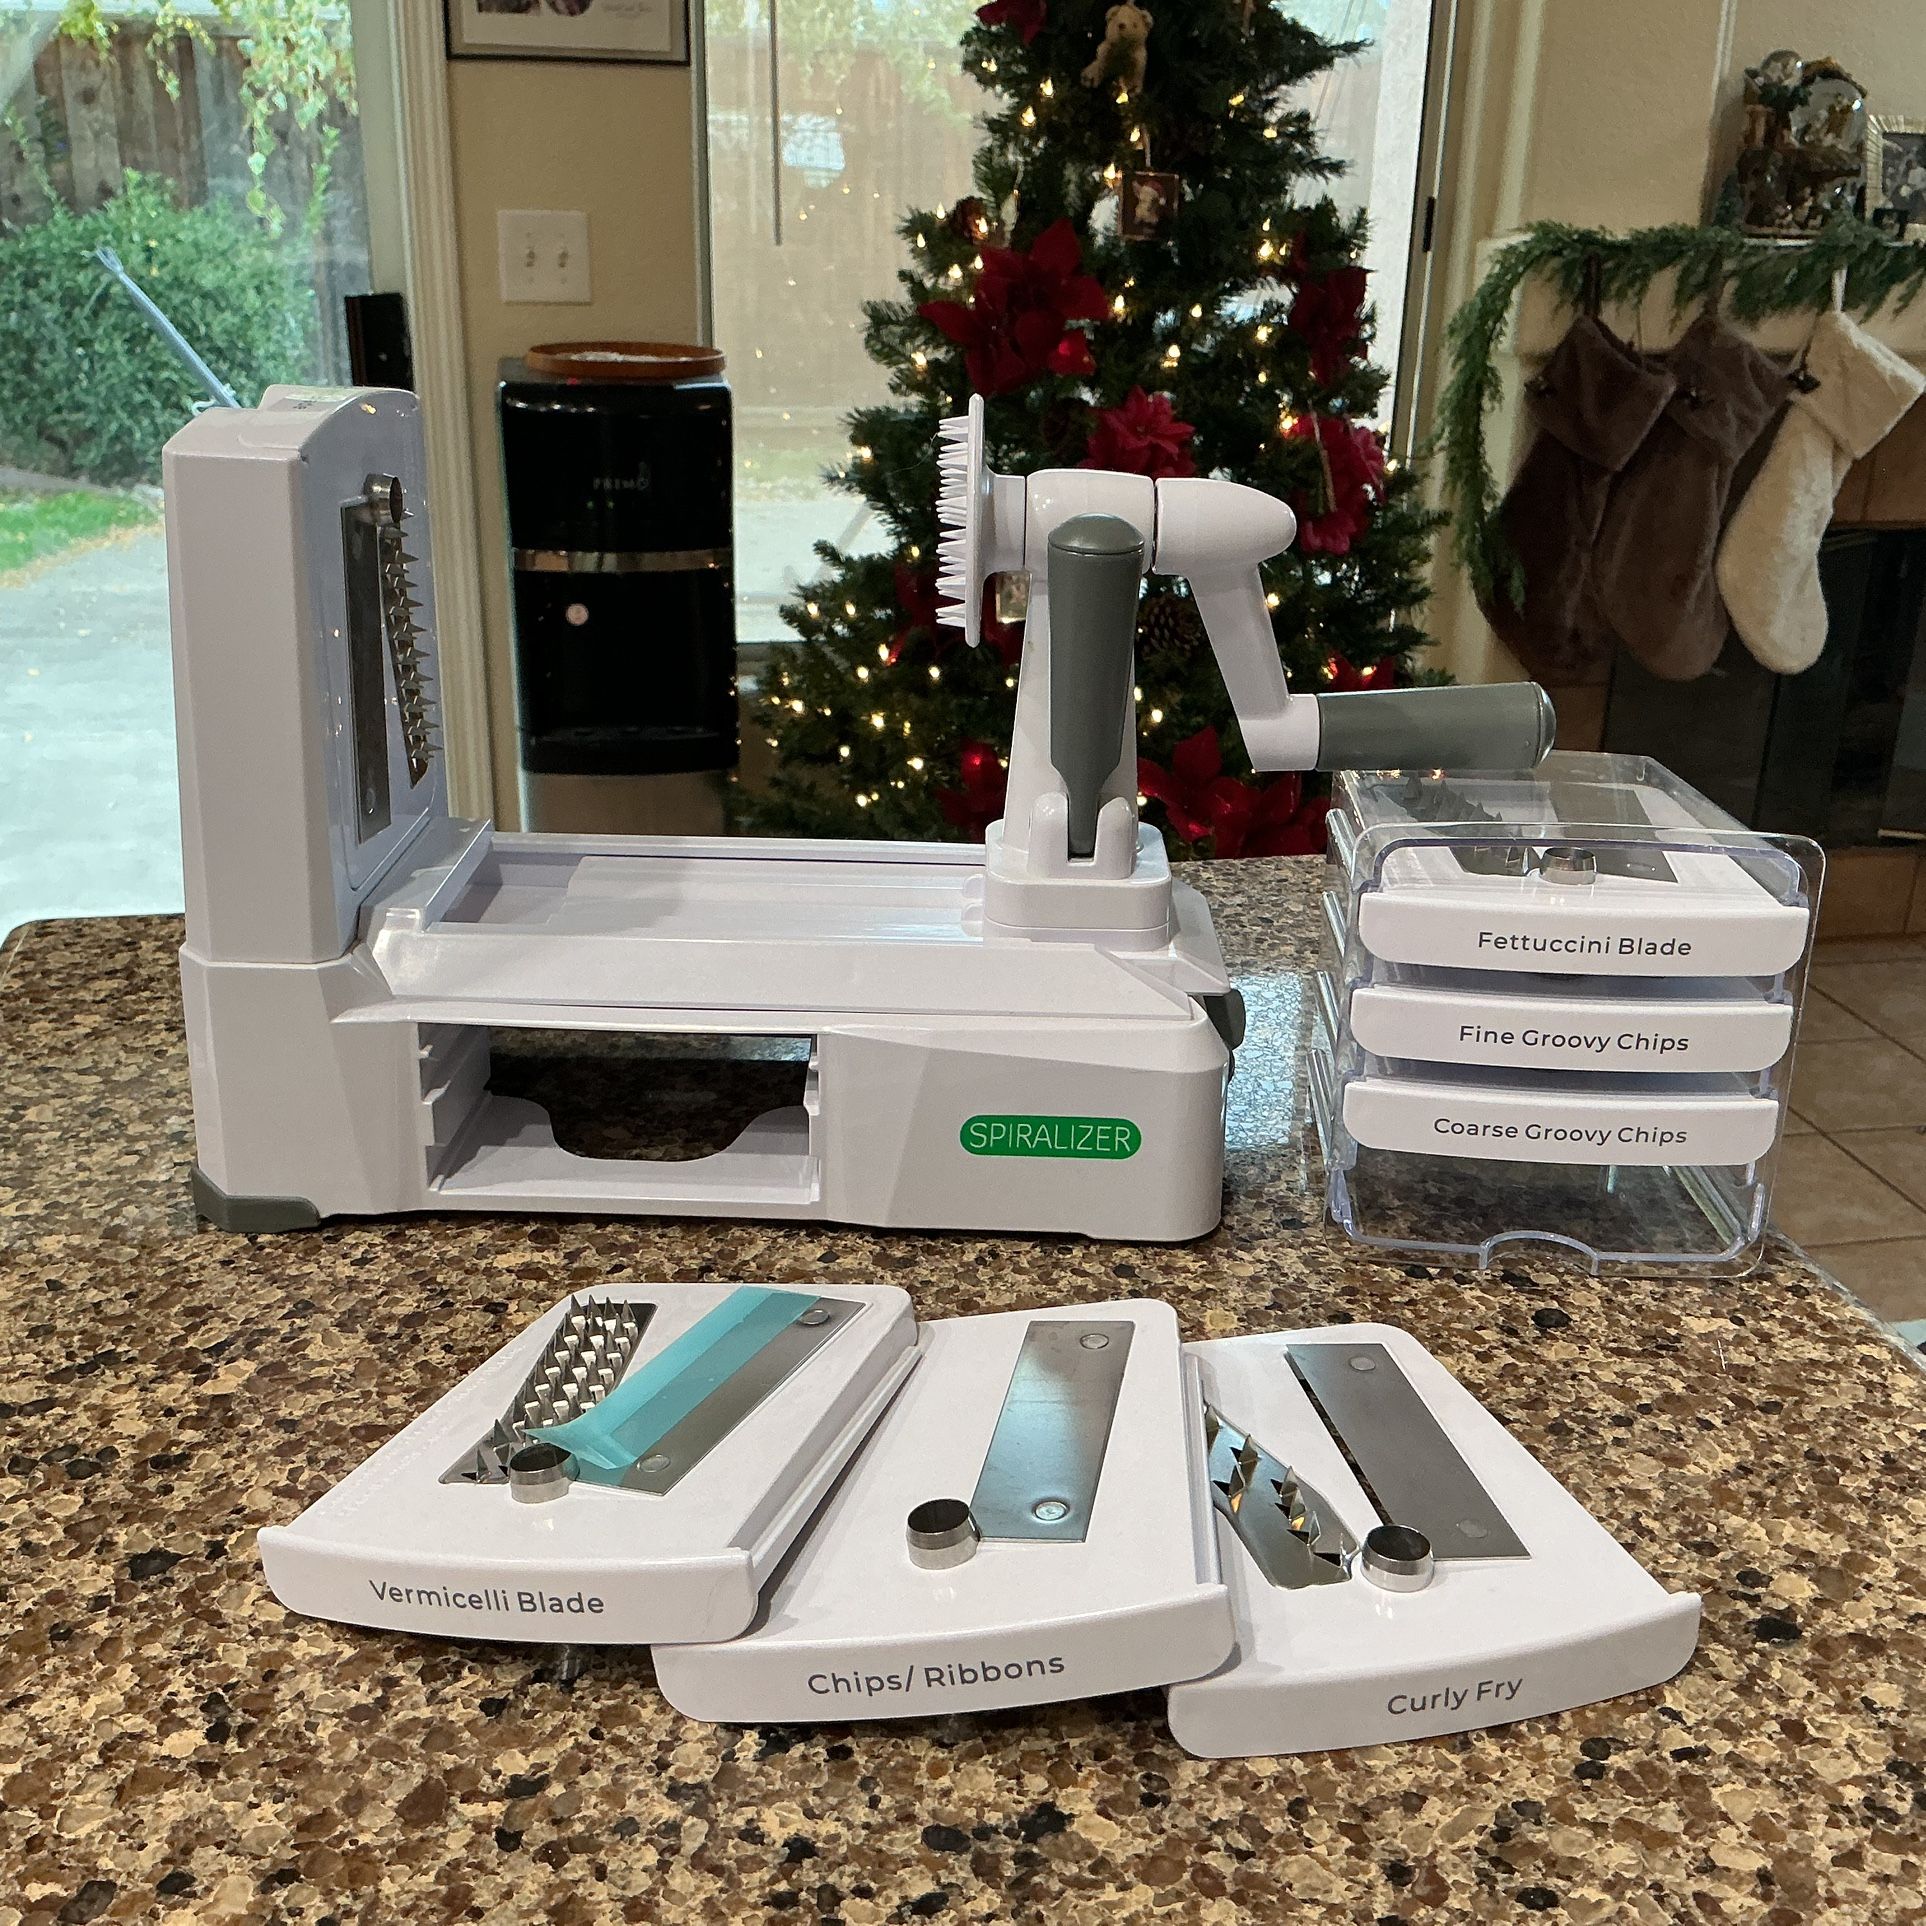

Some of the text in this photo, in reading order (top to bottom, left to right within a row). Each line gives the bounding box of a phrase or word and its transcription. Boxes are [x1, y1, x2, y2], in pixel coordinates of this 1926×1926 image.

[1477, 930, 1693, 957] Fettuccini Blade
[1459, 1024, 1690, 1055] Fine Groovy Chips
[969, 1122, 1132, 1152] SPIRALIZER
[1433, 1117, 1689, 1147] Coarse Groovy Chips
[368, 1578, 606, 1615] Vermicelli Blade
[807, 1655, 1066, 1698] Chips/ Ribbons
[1386, 1676, 1526, 1717] Curly Fry
